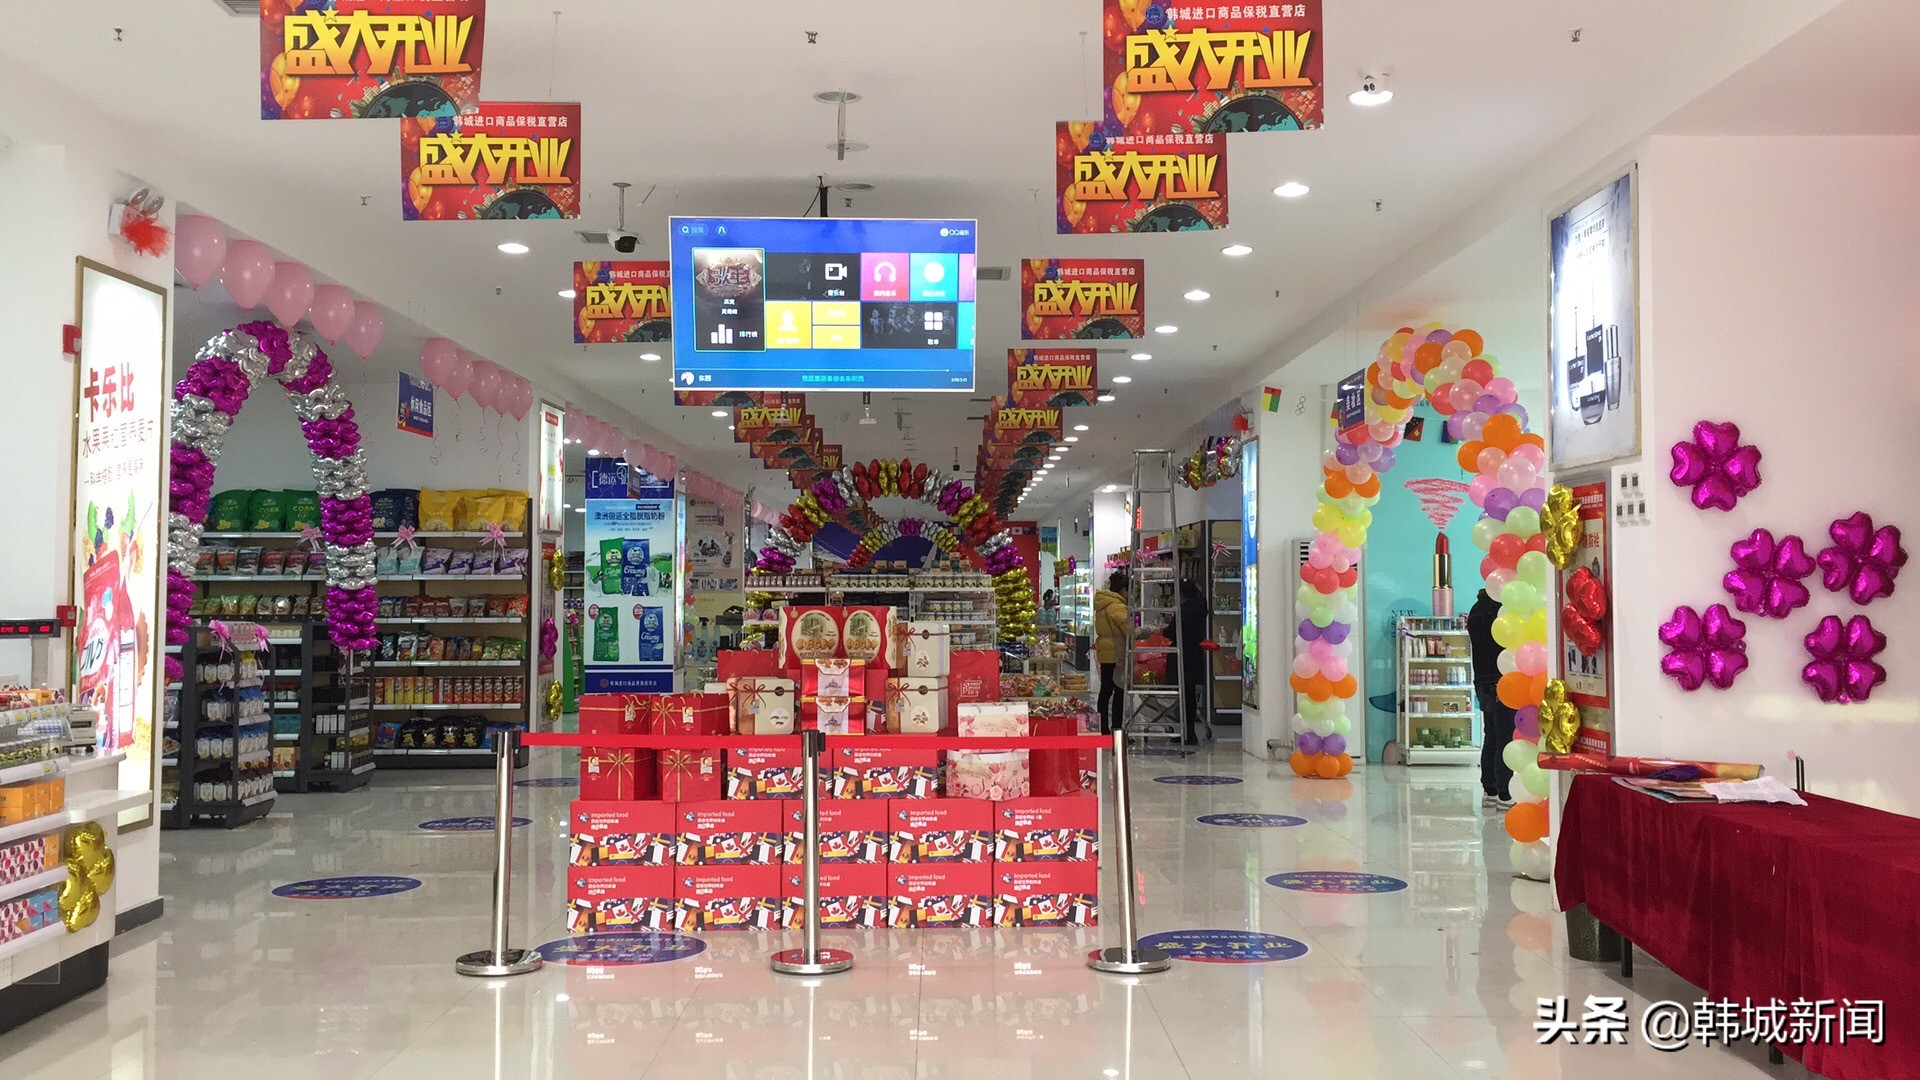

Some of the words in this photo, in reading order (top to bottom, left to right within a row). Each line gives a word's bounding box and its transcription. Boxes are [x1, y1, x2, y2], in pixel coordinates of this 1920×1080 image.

[1165, 4, 1306, 21] 韩城进口商品保税直营店
[284, 7, 474, 75] 盛大开业
[1126, 26, 1313, 92] 盛大开业
[453, 115, 568, 129] 韩城进口商品保税直营店
[420, 131, 572, 185] 盛大开业
[1074, 149, 1220, 201] 盛大开业
[1034, 279, 1139, 316] 盛大开业
[1017, 363, 1093, 391] 盛大开业
[83, 361, 135, 423] 卡乐比
[998, 408, 1060, 430] 盛大开业
[591, 812, 615, 820] Imported
[697, 811, 721, 819] Imported
[588, 877, 612, 885] Imported
